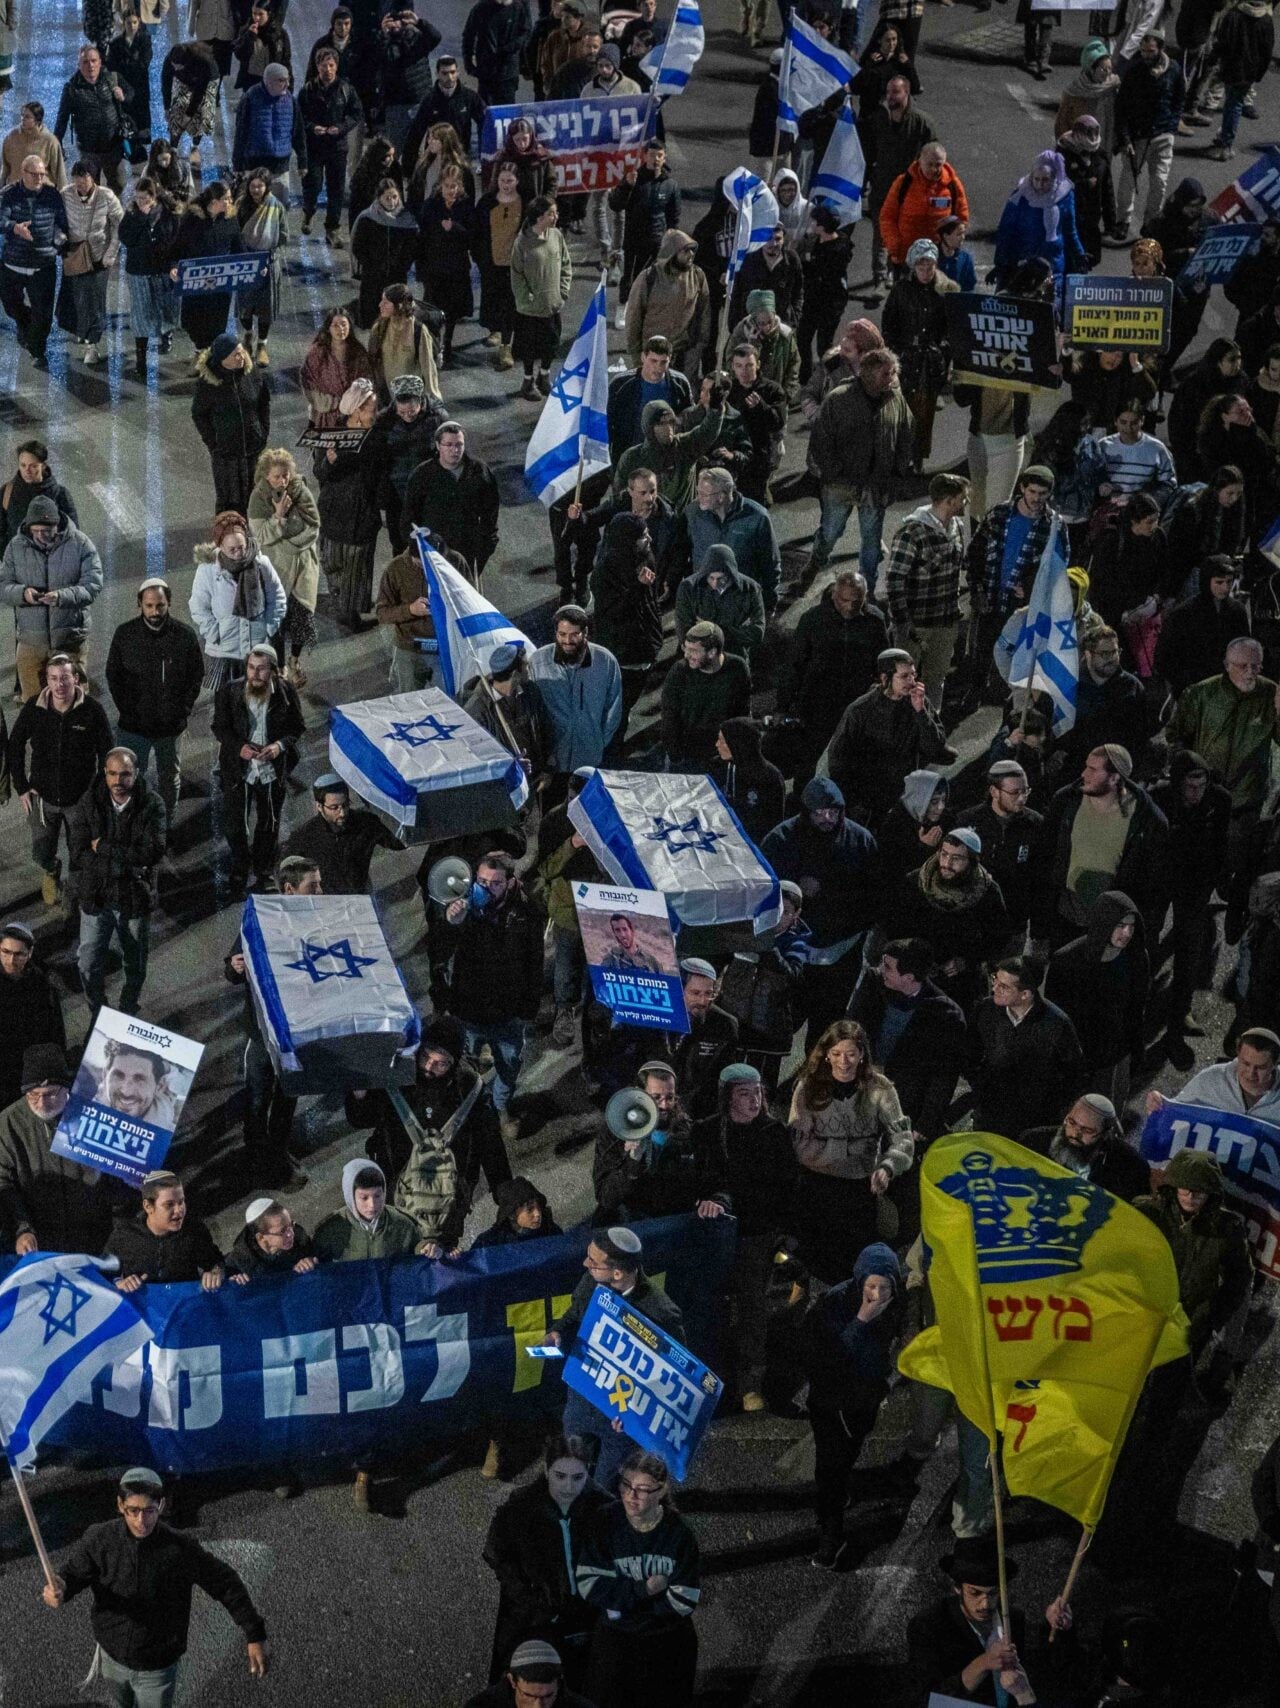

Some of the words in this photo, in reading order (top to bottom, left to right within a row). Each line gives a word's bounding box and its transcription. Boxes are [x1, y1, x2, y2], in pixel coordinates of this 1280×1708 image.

[494, 104, 602, 150] לניצן
[609, 107, 640, 140] כן
[188, 266, 225, 278] כולם
[231, 273, 256, 287] אין
[1074, 287, 1123, 301] החטופים
[1126, 288, 1164, 302] שחרור
[1078, 308, 1111, 321] ניצחון
[1113, 309, 1140, 322] מתוך
[1143, 310, 1159, 322] רק
[968, 313, 1035, 336] שכחו
[1073, 326, 1109, 339] האויב
[1112, 327, 1160, 341] והכנעת
[973, 330, 1029, 352] אותי
[602, 971, 617, 981] לנו
[637, 977, 669, 989] במותם
[605, 981, 671, 1007] ניצחון
[127, 1023, 160, 1042] הגבורה
[82, 1104, 98, 1118] לנו
[75, 1114, 151, 1159] ניצחון
[119, 1118, 155, 1142] במותם
[986, 1293, 1094, 1342] מש
[598, 1322, 655, 1381] כולם
[261, 1303, 471, 1420] לכם
[659, 1368, 696, 1415] בלי
[648, 1403, 689, 1451] אין
